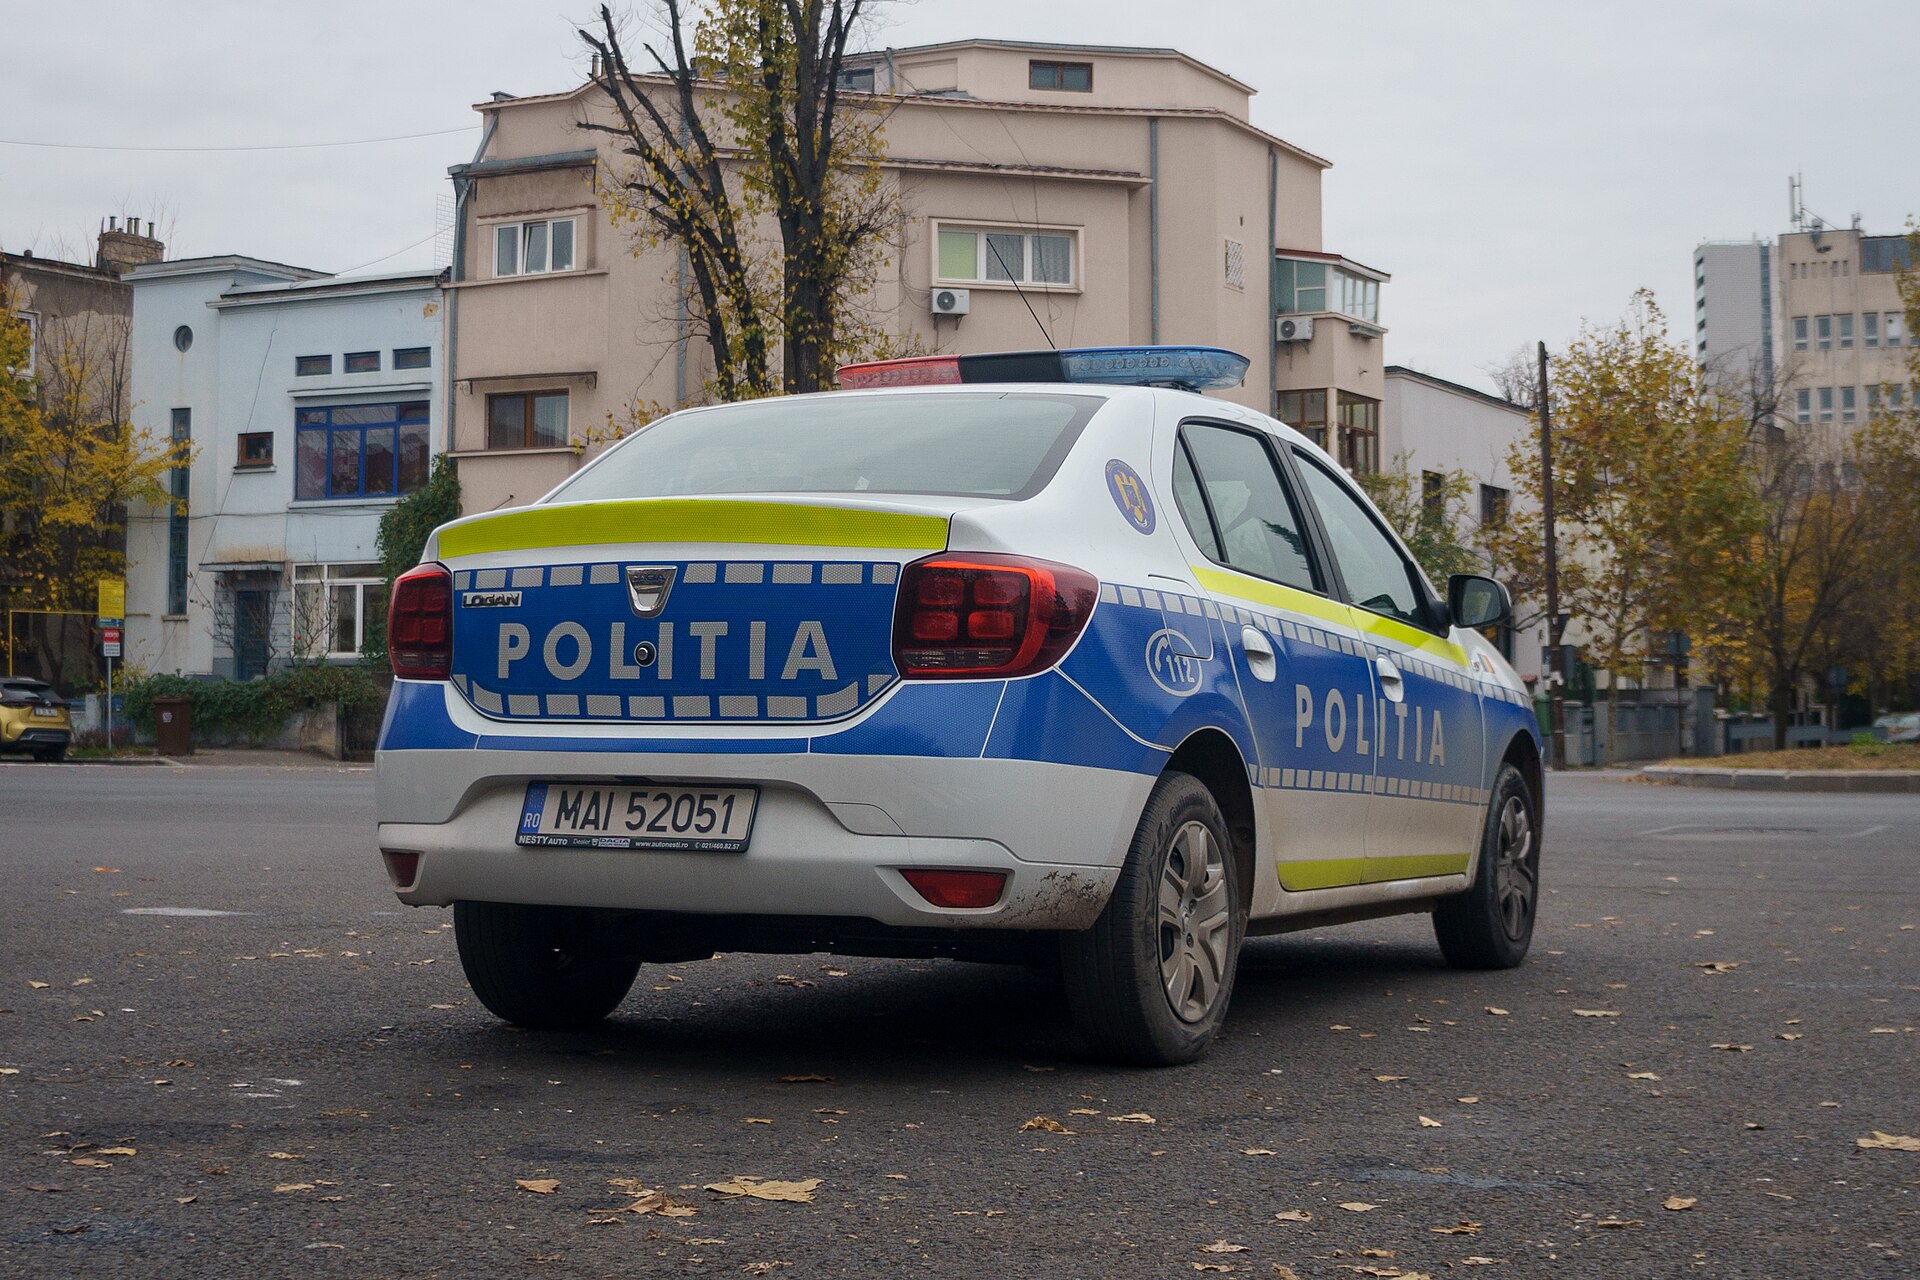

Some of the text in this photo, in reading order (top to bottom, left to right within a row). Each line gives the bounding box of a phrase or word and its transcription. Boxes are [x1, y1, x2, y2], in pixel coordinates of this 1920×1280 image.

[463, 592, 520, 607] LOGAN
[498, 621, 838, 681] POLITIA
[1165, 654, 1195, 683] 112
[1295, 683, 1445, 767] POLITIA
[523, 812, 541, 829] RO
[554, 790, 736, 834] MAI 52051
[518, 835, 548, 844] NESTY
[547, 837, 568, 846] AUTO
[572, 837, 591, 846] Dealer
[635, 840, 689, 849] www.autonesti.ro
